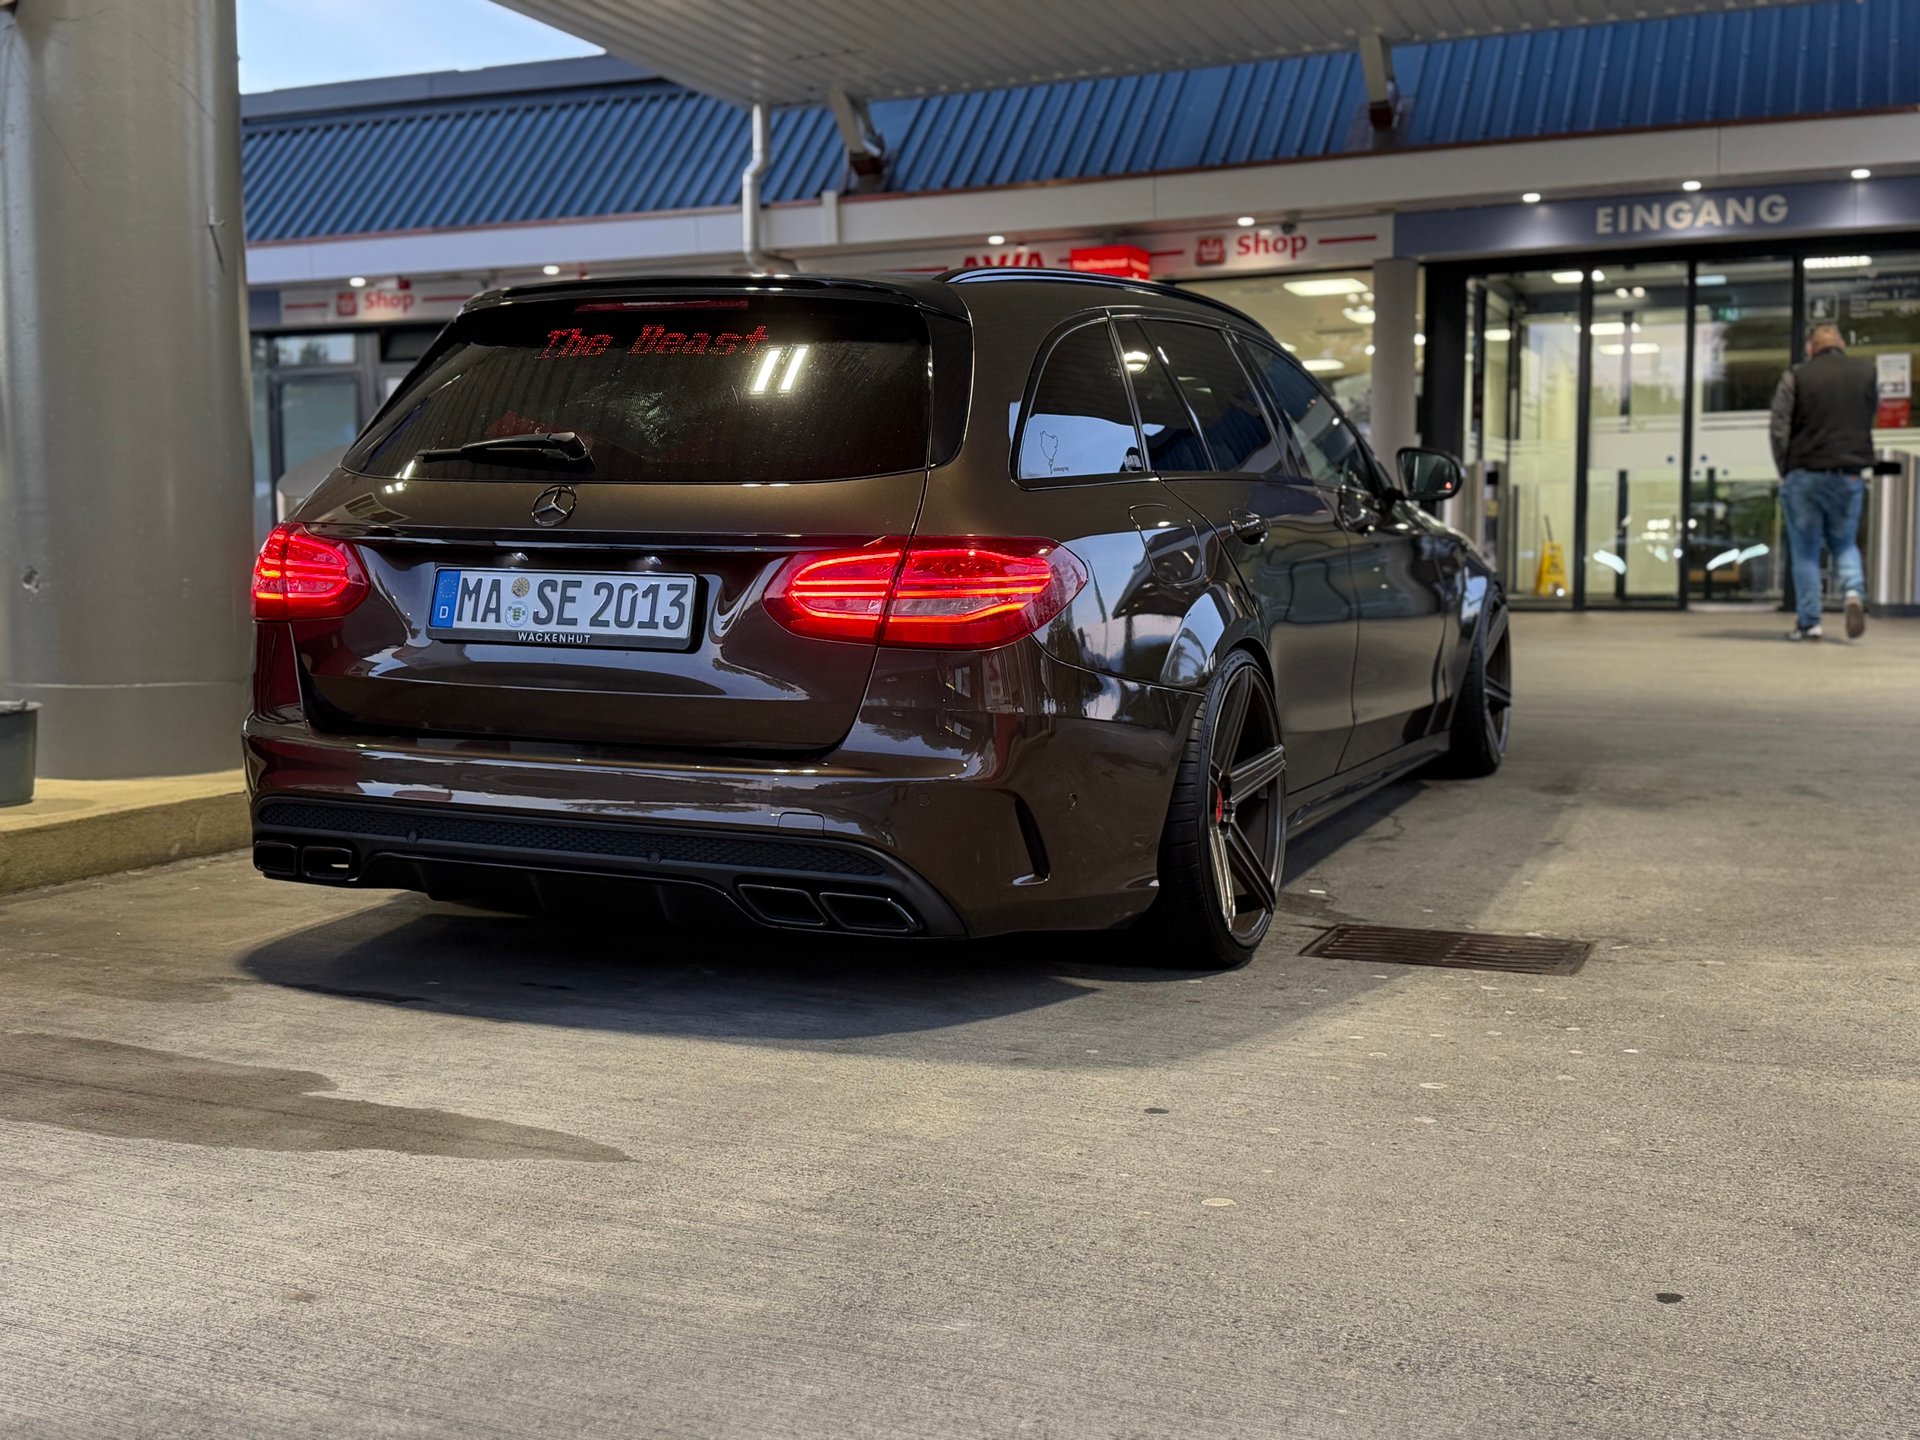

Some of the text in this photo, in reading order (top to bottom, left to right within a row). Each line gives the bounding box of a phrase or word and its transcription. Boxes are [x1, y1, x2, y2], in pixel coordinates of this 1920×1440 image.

[1595, 194, 1789, 234] EINGANG
[1236, 232, 1307, 260] Shop
[365, 290, 414, 315] Shop
[534, 324, 769, 359] The Beast
[439, 606, 448, 619] D
[456, 577, 502, 623] MA
[532, 579, 582, 626] SE
[589, 582, 689, 630] 2013
[517, 632, 591, 644] WACKENHUT
